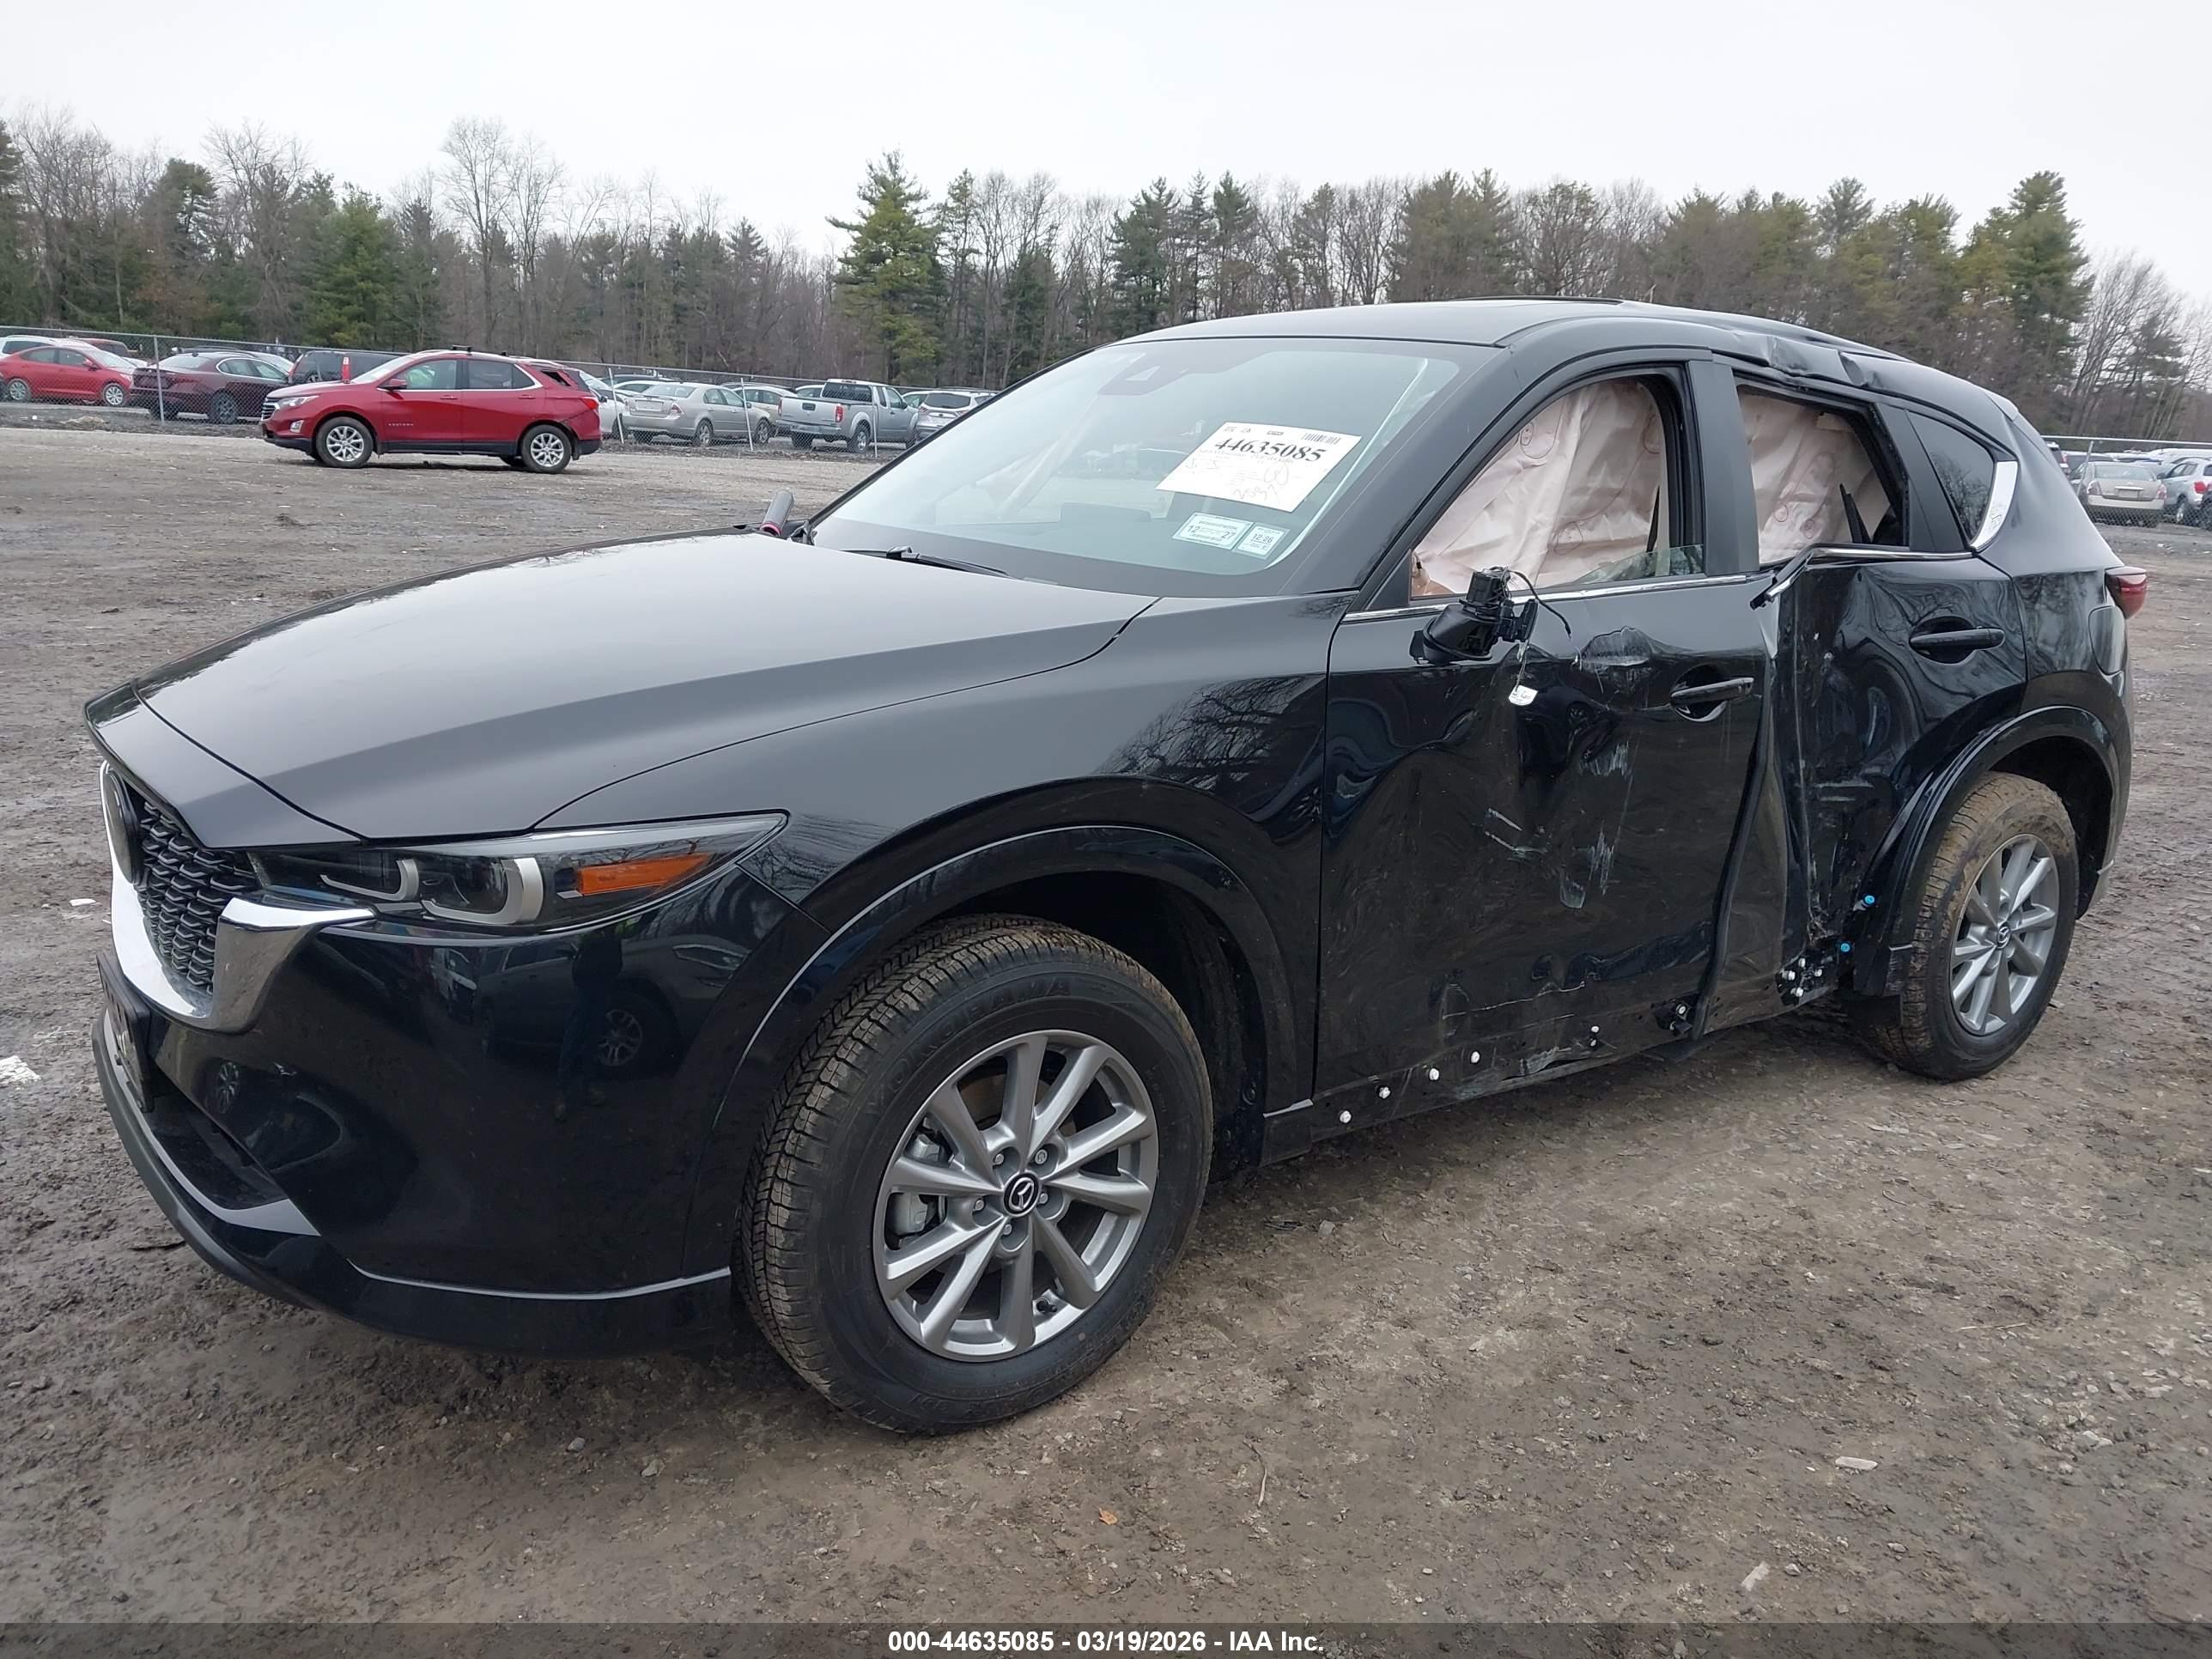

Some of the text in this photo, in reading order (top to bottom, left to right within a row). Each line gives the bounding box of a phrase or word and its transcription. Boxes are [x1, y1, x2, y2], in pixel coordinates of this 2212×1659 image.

[1214, 438, 1327, 461] 44635085
[1187, 525, 1200, 533] 12
[1220, 531, 1237, 540] 27
